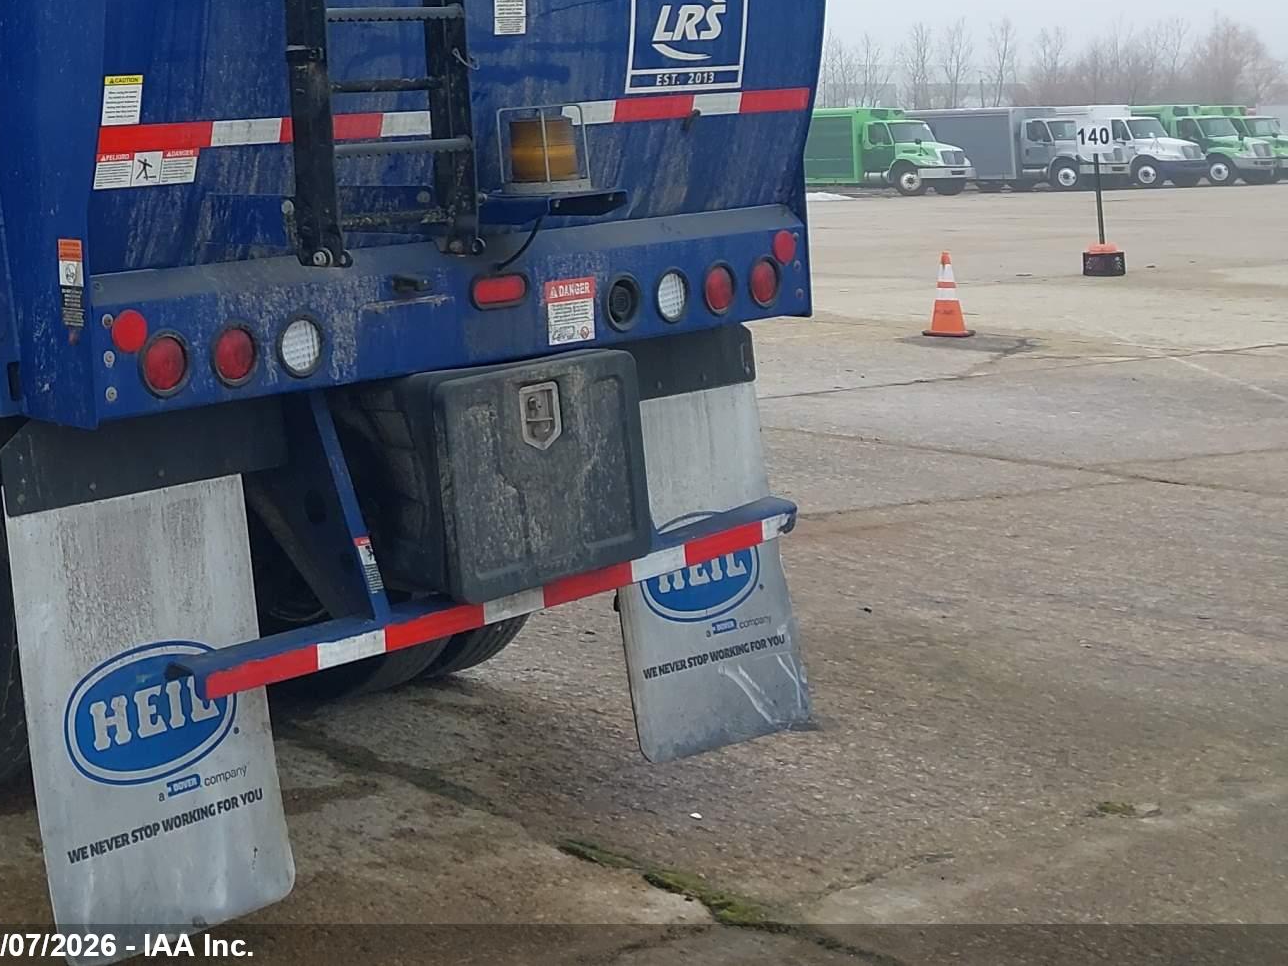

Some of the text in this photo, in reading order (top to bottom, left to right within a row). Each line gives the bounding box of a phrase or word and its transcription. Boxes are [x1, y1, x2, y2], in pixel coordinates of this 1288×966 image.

[652, 4, 727, 42] LRS
[656, 72, 715, 86] EST. 2013
[1077, 127, 1110, 145] 140
[559, 281, 591, 297] DANGER
[739, 615, 772, 629] company
[643, 634, 786, 680] WE NEVER STOP WORKING FOR YOU
[90, 674, 220, 752] HEIL
[158, 792, 165, 802] a
[204, 765, 247, 787] company
[68, 788, 263, 864] WE NEVER STOP WORKING FOR YOU
